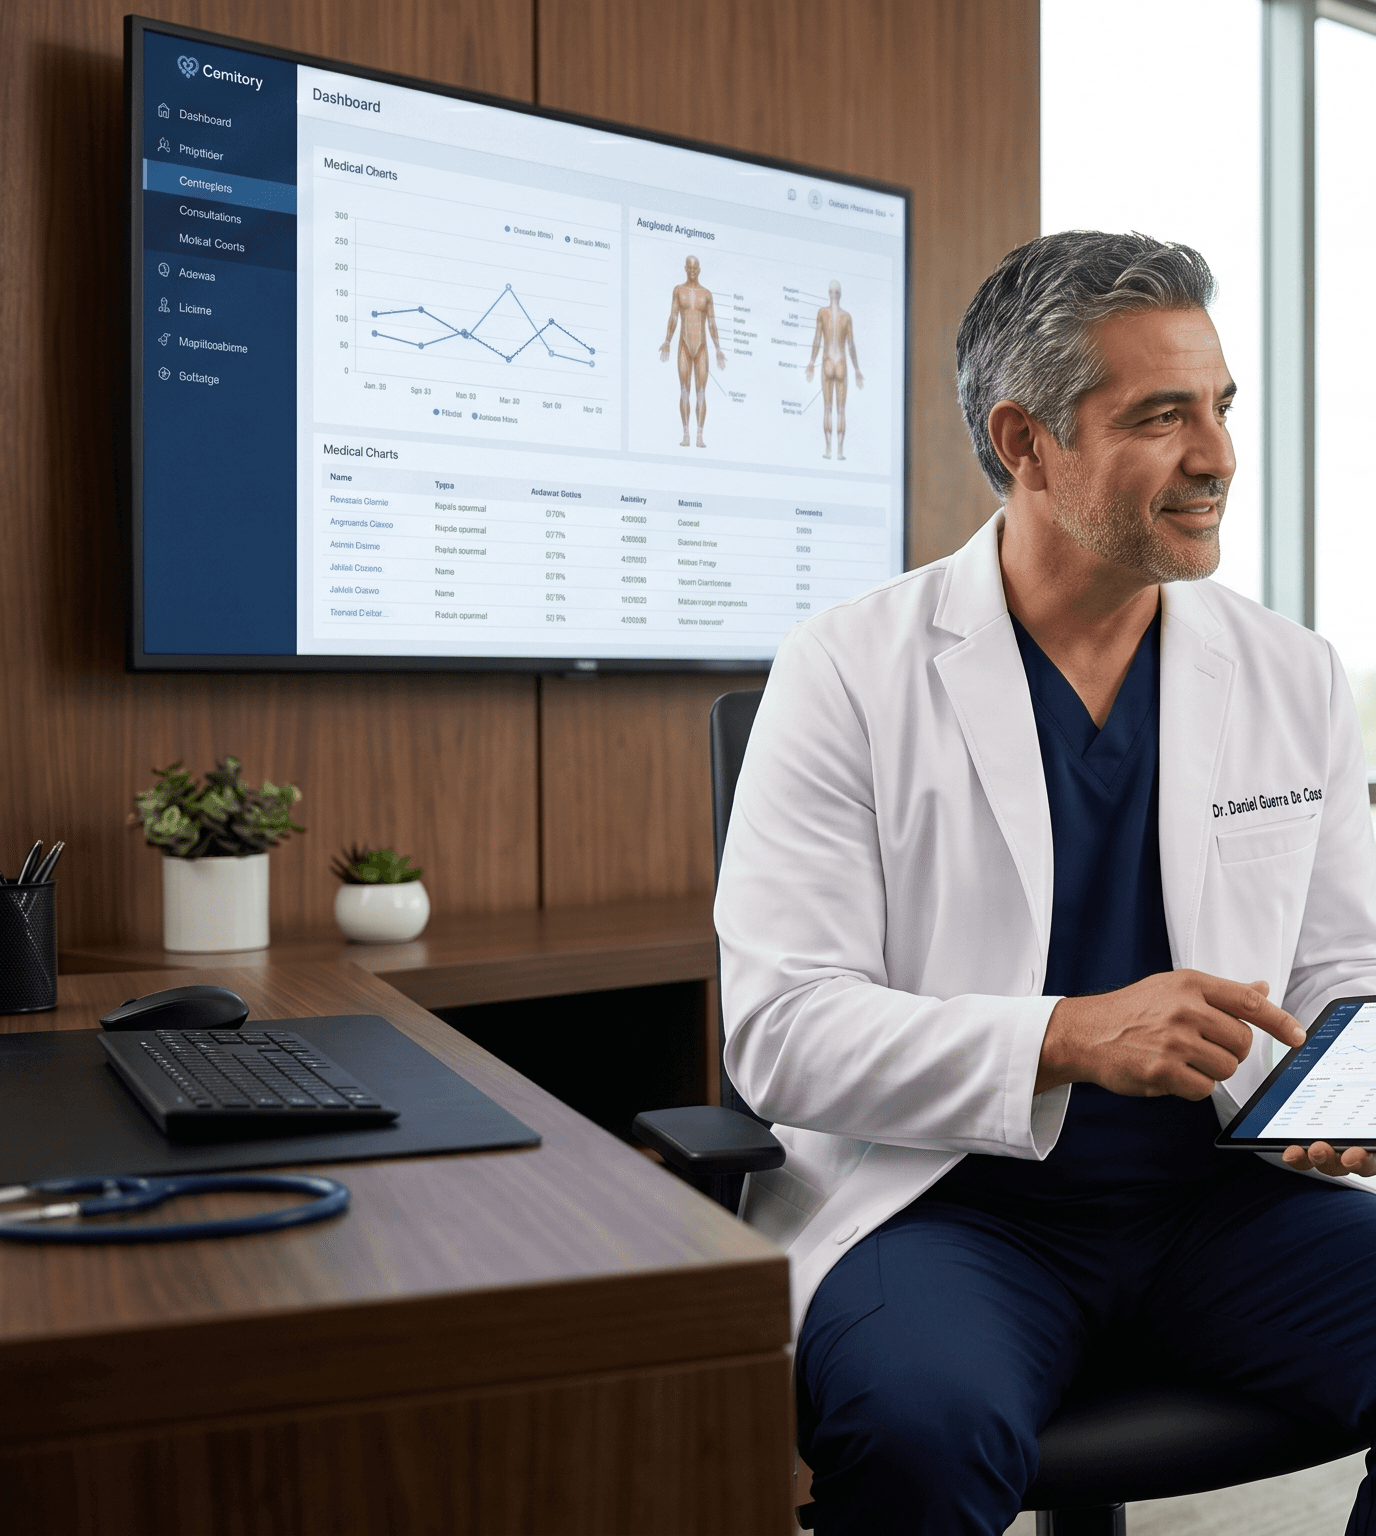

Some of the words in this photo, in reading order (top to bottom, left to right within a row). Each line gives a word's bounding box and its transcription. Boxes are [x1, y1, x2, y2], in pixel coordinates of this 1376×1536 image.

[203, 65, 263, 91] Cemitory
[313, 88, 380, 113] Dashboard
[180, 109, 231, 127] Dashboard
[325, 158, 363, 174] Medical
[180, 204, 243, 224] Consultations
[335, 211, 348, 220] 300
[335, 237, 348, 245] 250
[335, 263, 348, 271] 200
[336, 289, 348, 297] 150
[340, 341, 348, 349] 50
[324, 444, 363, 456] Medical
[366, 449, 398, 459] Charts
[330, 473, 352, 481] Name
[1213, 803, 1229, 818] Dr.
[1228, 796, 1258, 815] Daniel
[1259, 795, 1289, 809] Guerra
[1304, 788, 1322, 802] Coss
